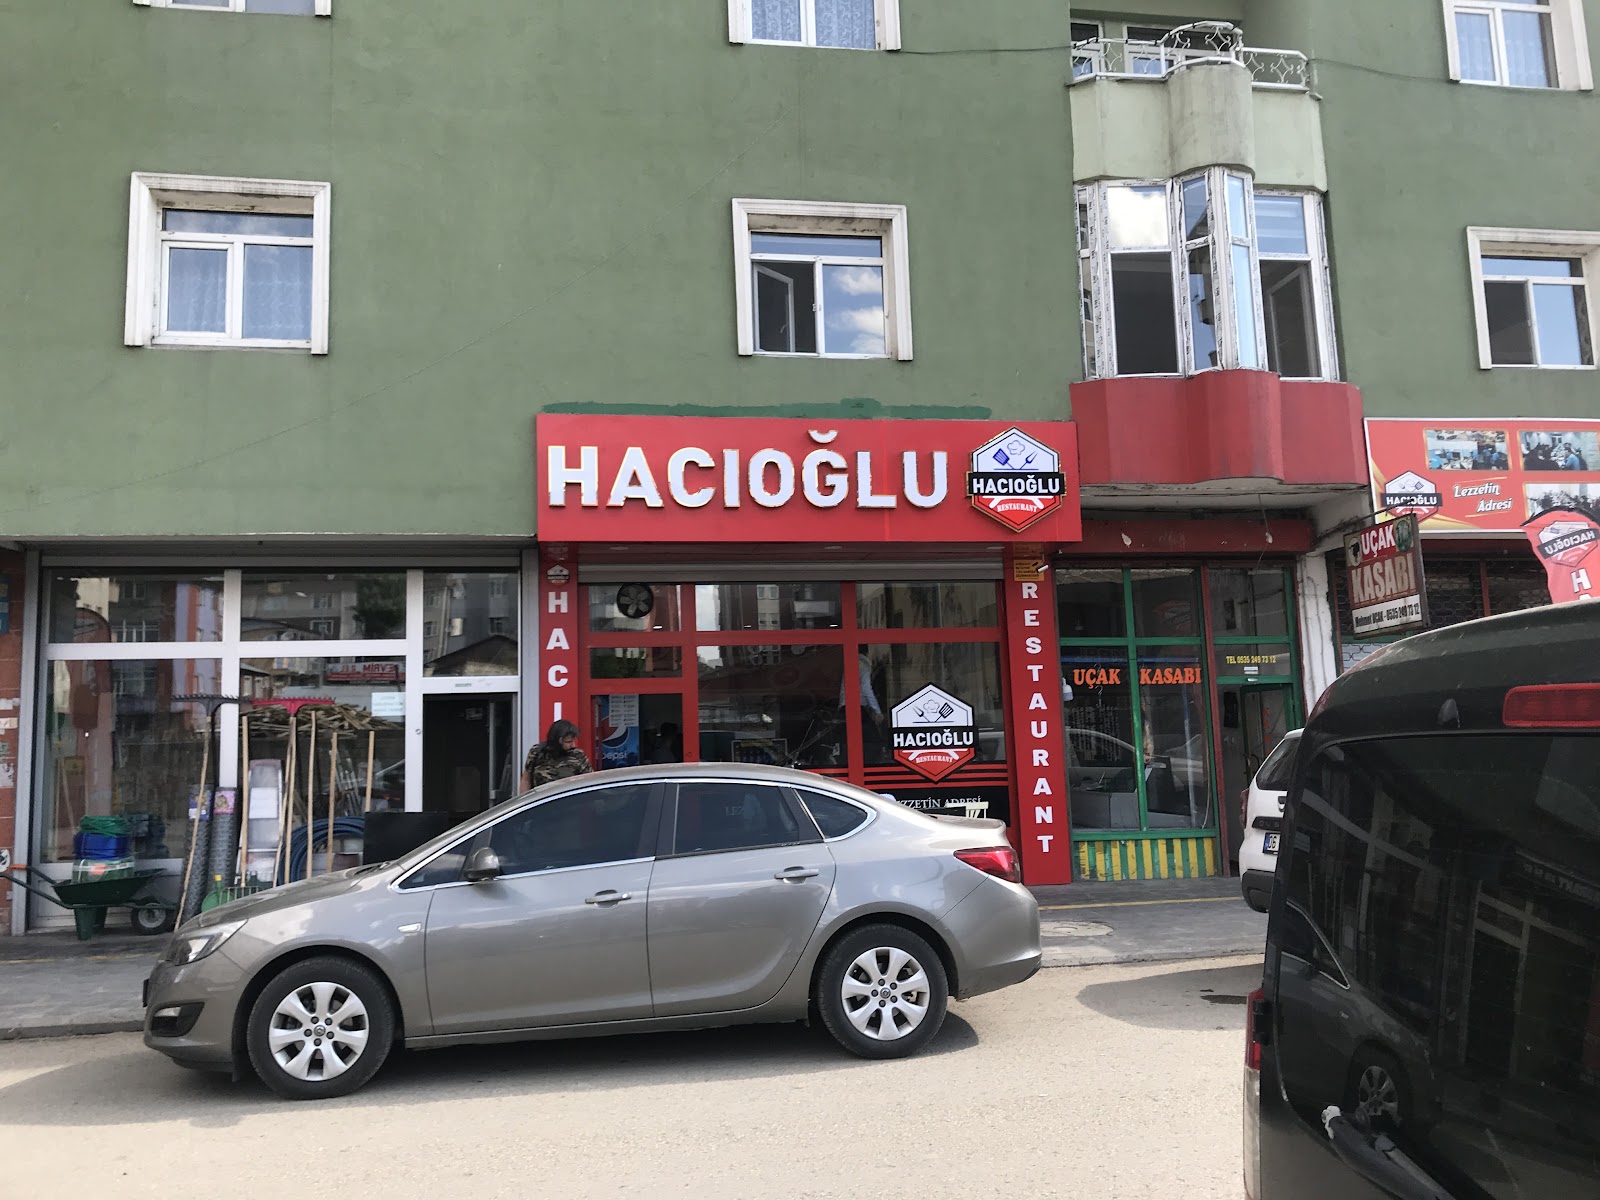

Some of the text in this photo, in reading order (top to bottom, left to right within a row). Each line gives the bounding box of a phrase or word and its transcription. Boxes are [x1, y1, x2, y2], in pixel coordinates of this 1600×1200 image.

[547, 429, 949, 508] HACIOĞLU
[972, 474, 1060, 494] HACIOĞLU
[1453, 482, 1500, 498] Lezzetin
[997, 500, 1038, 513] RESTAURANT
[1476, 497, 1513, 512] Adresi
[1361, 524, 1396, 557] UÇAK
[1352, 552, 1416, 603] KASABI
[1226, 655, 1236, 665] TEL
[1237, 655, 1250, 664] 0535
[1073, 668, 1202, 689] UÇAK KASABI
[1021, 582, 1054, 853] RESTAURANT
[893, 729, 974, 747] HACIOĞLU
[915, 755, 954, 764] RESTAURANT
